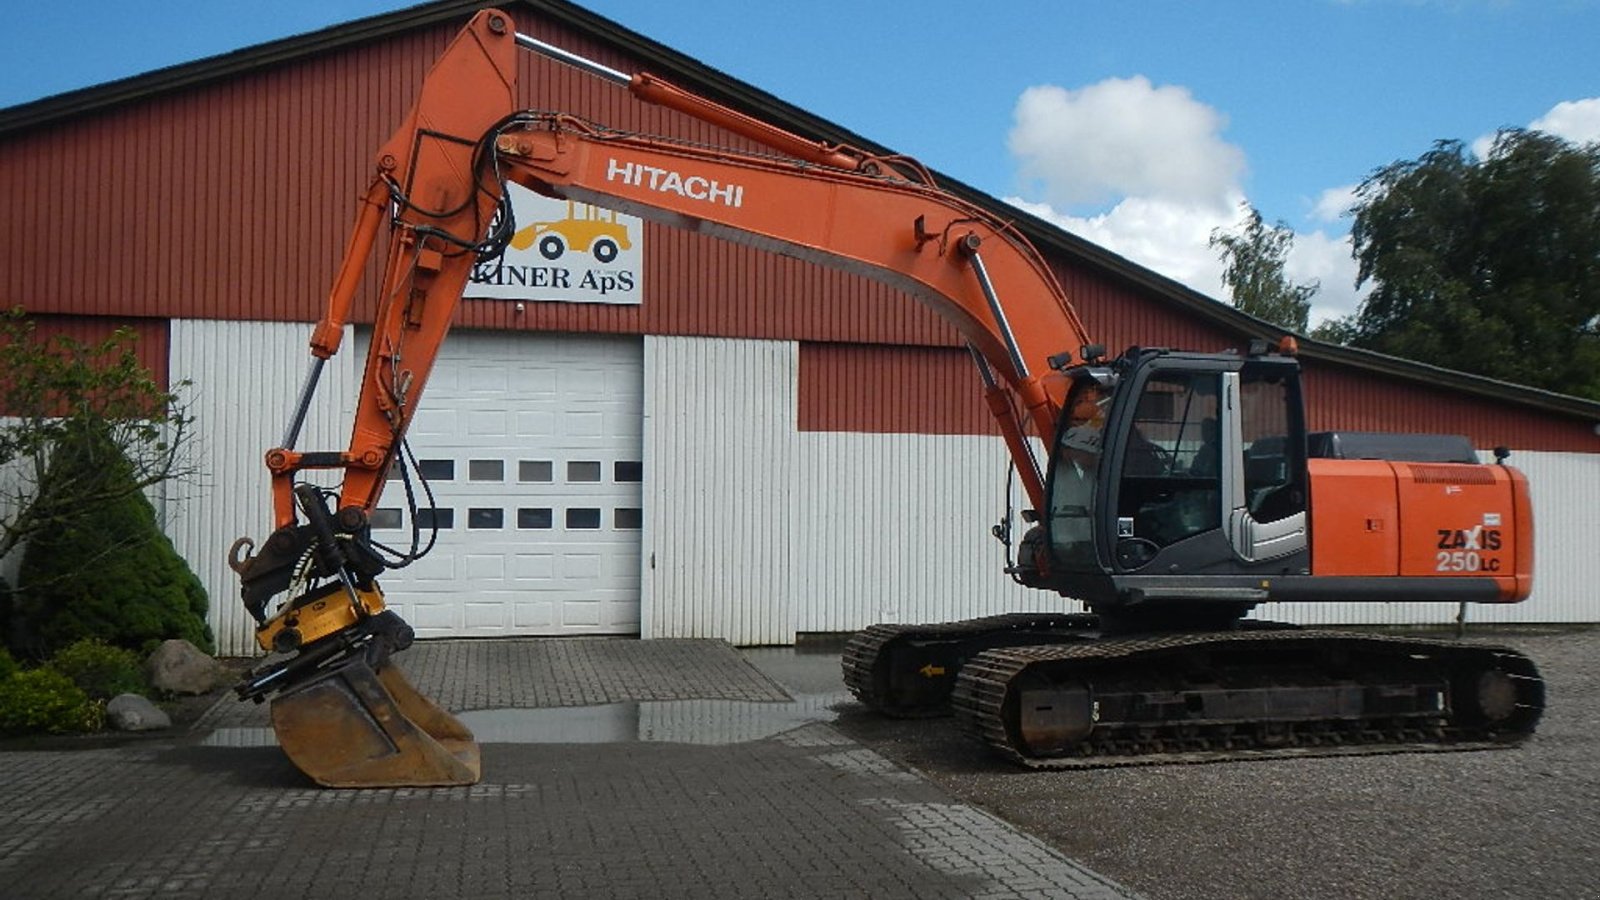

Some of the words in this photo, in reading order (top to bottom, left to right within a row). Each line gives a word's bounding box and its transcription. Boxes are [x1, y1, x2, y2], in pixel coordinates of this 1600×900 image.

[607, 158, 744, 208] HITACHI
[578, 269, 634, 294] ApS
[1437, 525, 1502, 551] ZAXIS
